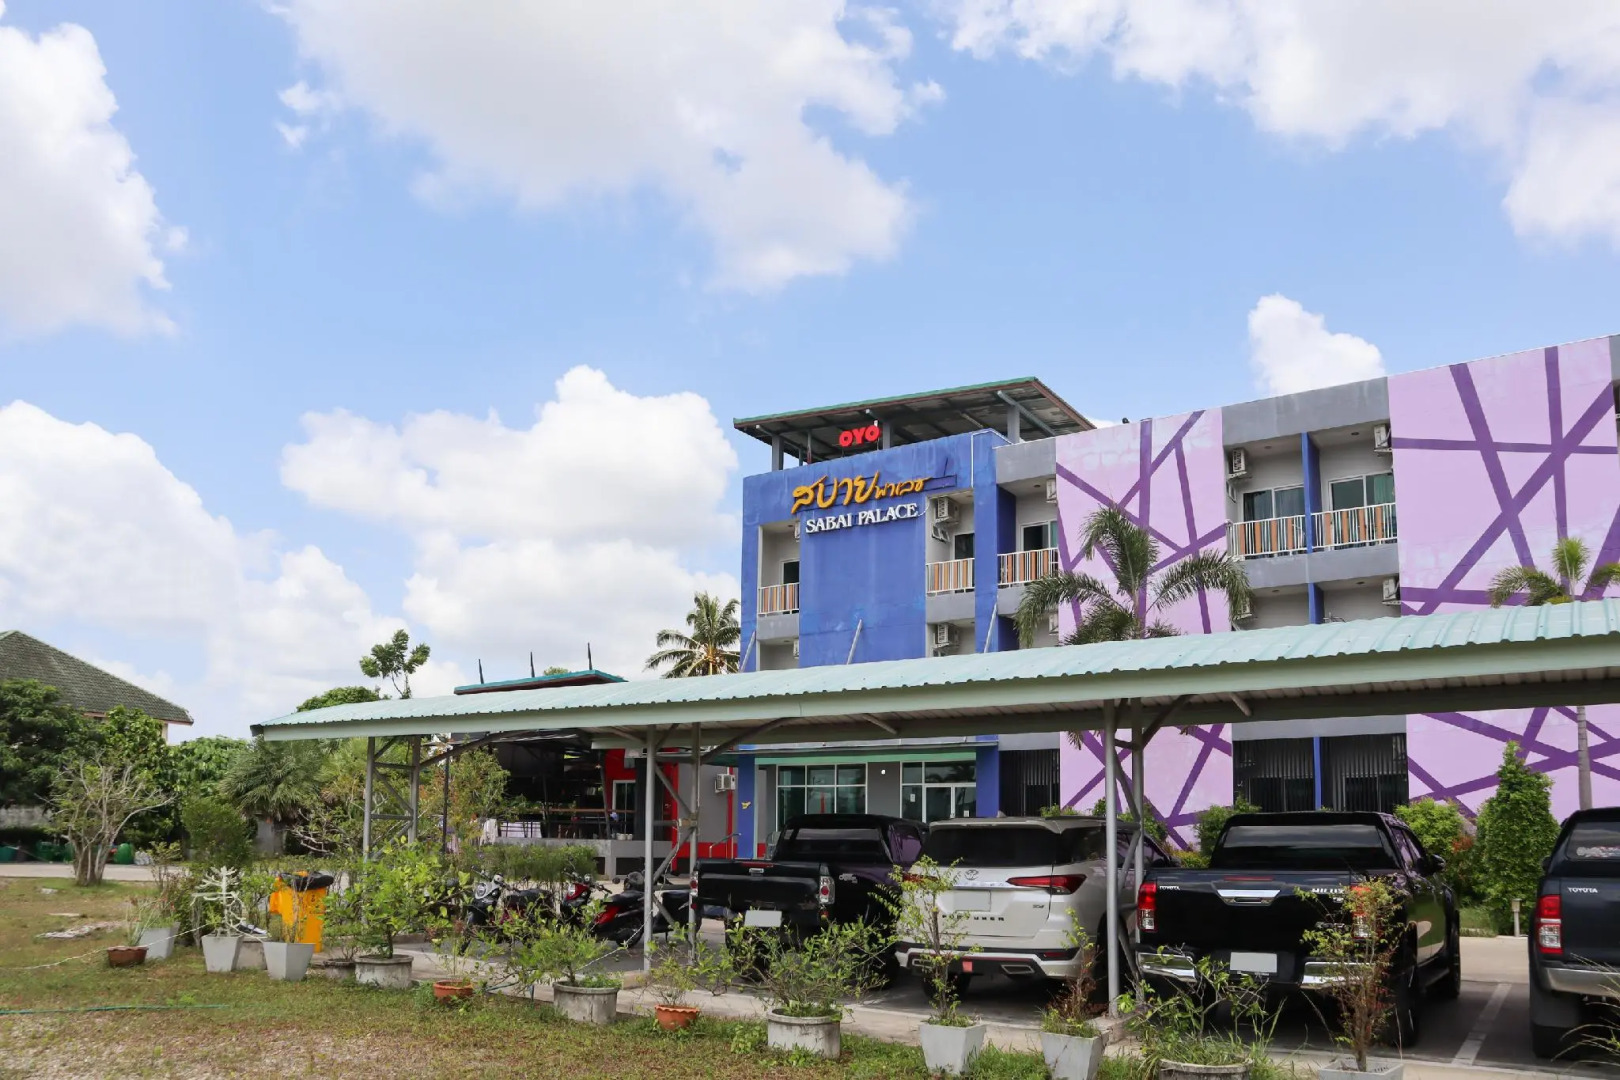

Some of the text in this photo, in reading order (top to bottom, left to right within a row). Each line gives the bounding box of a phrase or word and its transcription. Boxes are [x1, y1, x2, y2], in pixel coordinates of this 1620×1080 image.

[839, 425, 880, 447] OYO
[805, 502, 919, 534] SABAI PALACE
